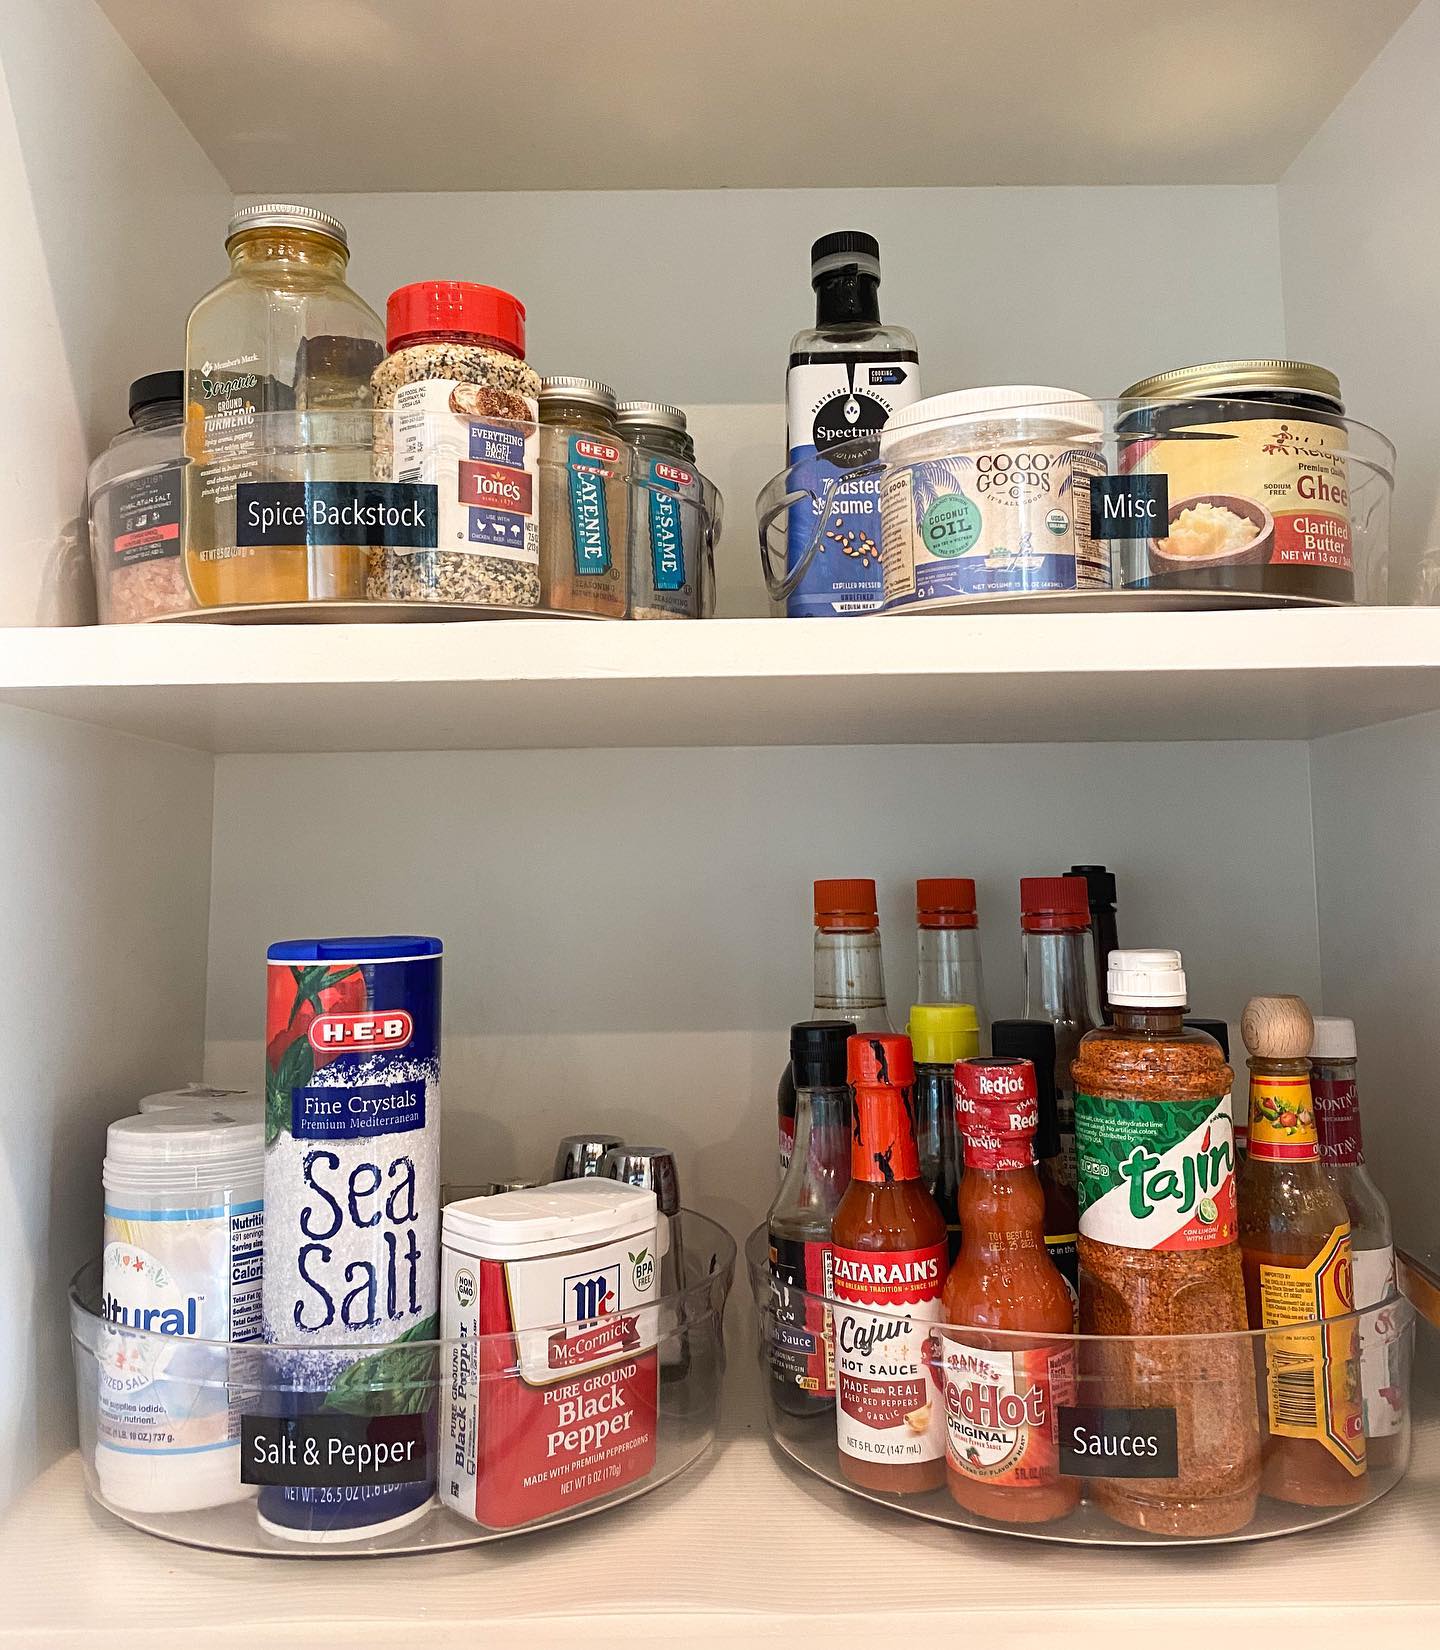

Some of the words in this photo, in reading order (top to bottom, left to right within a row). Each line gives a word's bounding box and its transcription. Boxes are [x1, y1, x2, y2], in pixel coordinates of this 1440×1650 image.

[218, 398, 242, 412] GROUND
[812, 387, 846, 414] PARTNERS
[866, 390, 894, 413] COOKING
[204, 406, 256, 432] TURMERIC
[471, 428, 523, 447] EVERYTHING
[485, 441, 511, 460] BAGEL
[976, 454, 1050, 473] COCO
[1298, 462, 1330, 474] Premium
[472, 474, 521, 501] Tone's
[976, 472, 1050, 493] GOODS
[1296, 474, 1348, 507] Ghee
[154, 492, 172, 503] SALT
[986, 494, 1002, 504] IT'S
[1104, 493, 1158, 519] Misc
[248, 501, 306, 533] Spice
[313, 498, 426, 527] Backstock
[578, 472, 602, 560] CAYENNE
[929, 507, 969, 526] COCONUT
[656, 492, 678, 573] SESAME
[930, 518, 972, 540] OIL
[1293, 517, 1348, 540] Clarified
[1304, 534, 1344, 554] Butter
[1281, 550, 1299, 560] NET
[1302, 552, 1316, 561] WT
[1318, 552, 1328, 562] 13
[654, 594, 688, 607] SEASONING
[862, 602, 876, 610] HEAT
[979, 1075, 1024, 1096] RedHot
[304, 1097, 342, 1114] Fine
[348, 1090, 418, 1116] Crystals
[301, 1118, 346, 1130] Premium
[350, 1112, 420, 1129] Mediterranean
[1115, 1126, 1138, 1134] artificial
[1116, 1119, 1149, 1128] dehydrated
[967, 1134, 1002, 1150] RedHot
[1098, 1130, 1127, 1140] Distributed
[300, 1150, 419, 1241] Sea
[232, 1214, 264, 1230] Nutriti
[232, 1233, 242, 1242] 491
[1006, 1231, 1023, 1241] BEST
[1025, 1230, 1033, 1240] BY
[1203, 1233, 1217, 1241] LIME
[232, 1241, 252, 1253] Serving
[989, 1241, 1006, 1252] DEC
[1008, 1240, 1018, 1251] 25
[232, 1260, 251, 1268] Amount
[232, 1262, 263, 1280] Calori
[636, 1260, 654, 1279] BPA
[834, 1256, 938, 1284] ZATARAIN'S
[294, 1229, 422, 1334] Salt
[459, 1276, 473, 1288] NON
[638, 1275, 652, 1286] FREE
[845, 1281, 868, 1292] ORLEANS
[870, 1284, 902, 1293] TRADITION
[910, 1282, 926, 1291] SINCE
[232, 1294, 246, 1304] Total
[246, 1292, 255, 1300] Fat
[458, 1285, 474, 1297] GMO
[232, 1304, 252, 1315] Sodium
[232, 1317, 246, 1327] Total
[232, 1328, 251, 1338] Protein
[552, 1319, 631, 1362] McCormick
[782, 1330, 812, 1347] Sauce
[840, 1313, 913, 1358] Cajun
[458, 1322, 471, 1400] Pepper
[840, 1357, 863, 1374] HOT
[870, 1364, 918, 1376] SAUCE
[126, 1374, 150, 1391] SALT
[543, 1383, 580, 1406] PURE
[582, 1364, 637, 1393] GROUND
[842, 1378, 869, 1395] MADE
[888, 1384, 919, 1396] REAL
[138, 1404, 167, 1414] iodide,
[558, 1384, 626, 1428] Black
[844, 1392, 860, 1404] AGED
[862, 1397, 879, 1406] RED
[880, 1398, 918, 1408] PEPPERS
[944, 1380, 1046, 1429] edHot
[124, 1416, 157, 1425] nutrient.
[450, 1403, 458, 1438] PURE
[866, 1409, 900, 1422] GARLIC
[152, 1434, 166, 1442] 737
[455, 1406, 467, 1468] Black
[546, 1409, 634, 1458] Pepper
[947, 1416, 1014, 1444] ORIGINAL
[846, 1436, 858, 1450] NET
[858, 1440, 864, 1451] 5
[864, 1440, 873, 1453] FL
[874, 1442, 885, 1454] OZ
[886, 1442, 904, 1456] (147
[906, 1442, 922, 1456] mL)
[969, 1438, 986, 1449] PEPPER
[986, 1442, 1002, 1451] SAUCE
[1073, 1426, 1158, 1457] Sauces
[253, 1435, 297, 1466] Salt
[303, 1438, 320, 1466] &
[328, 1438, 416, 1473] Pepper
[523, 1472, 548, 1488] MADE
[549, 1464, 570, 1480] WITH
[572, 1450, 606, 1472] PREMIUM
[606, 1434, 649, 1460] PEPPERCORNS
[960, 1460, 978, 1476] BLEND
[989, 1461, 1014, 1476] FLAVOR
[1018, 1434, 1026, 1456] HEAT
[560, 1481, 574, 1496] NET
[574, 1476, 586, 1489] WT
[587, 1474, 593, 1486] 6
[593, 1470, 602, 1483] OZ
[602, 1463, 622, 1482] (170g)
[284, 1487, 300, 1501] NET
[301, 1487, 318, 1503] WT.
[320, 1487, 342, 1503] 26.5
[345, 1486, 358, 1501] OZ
